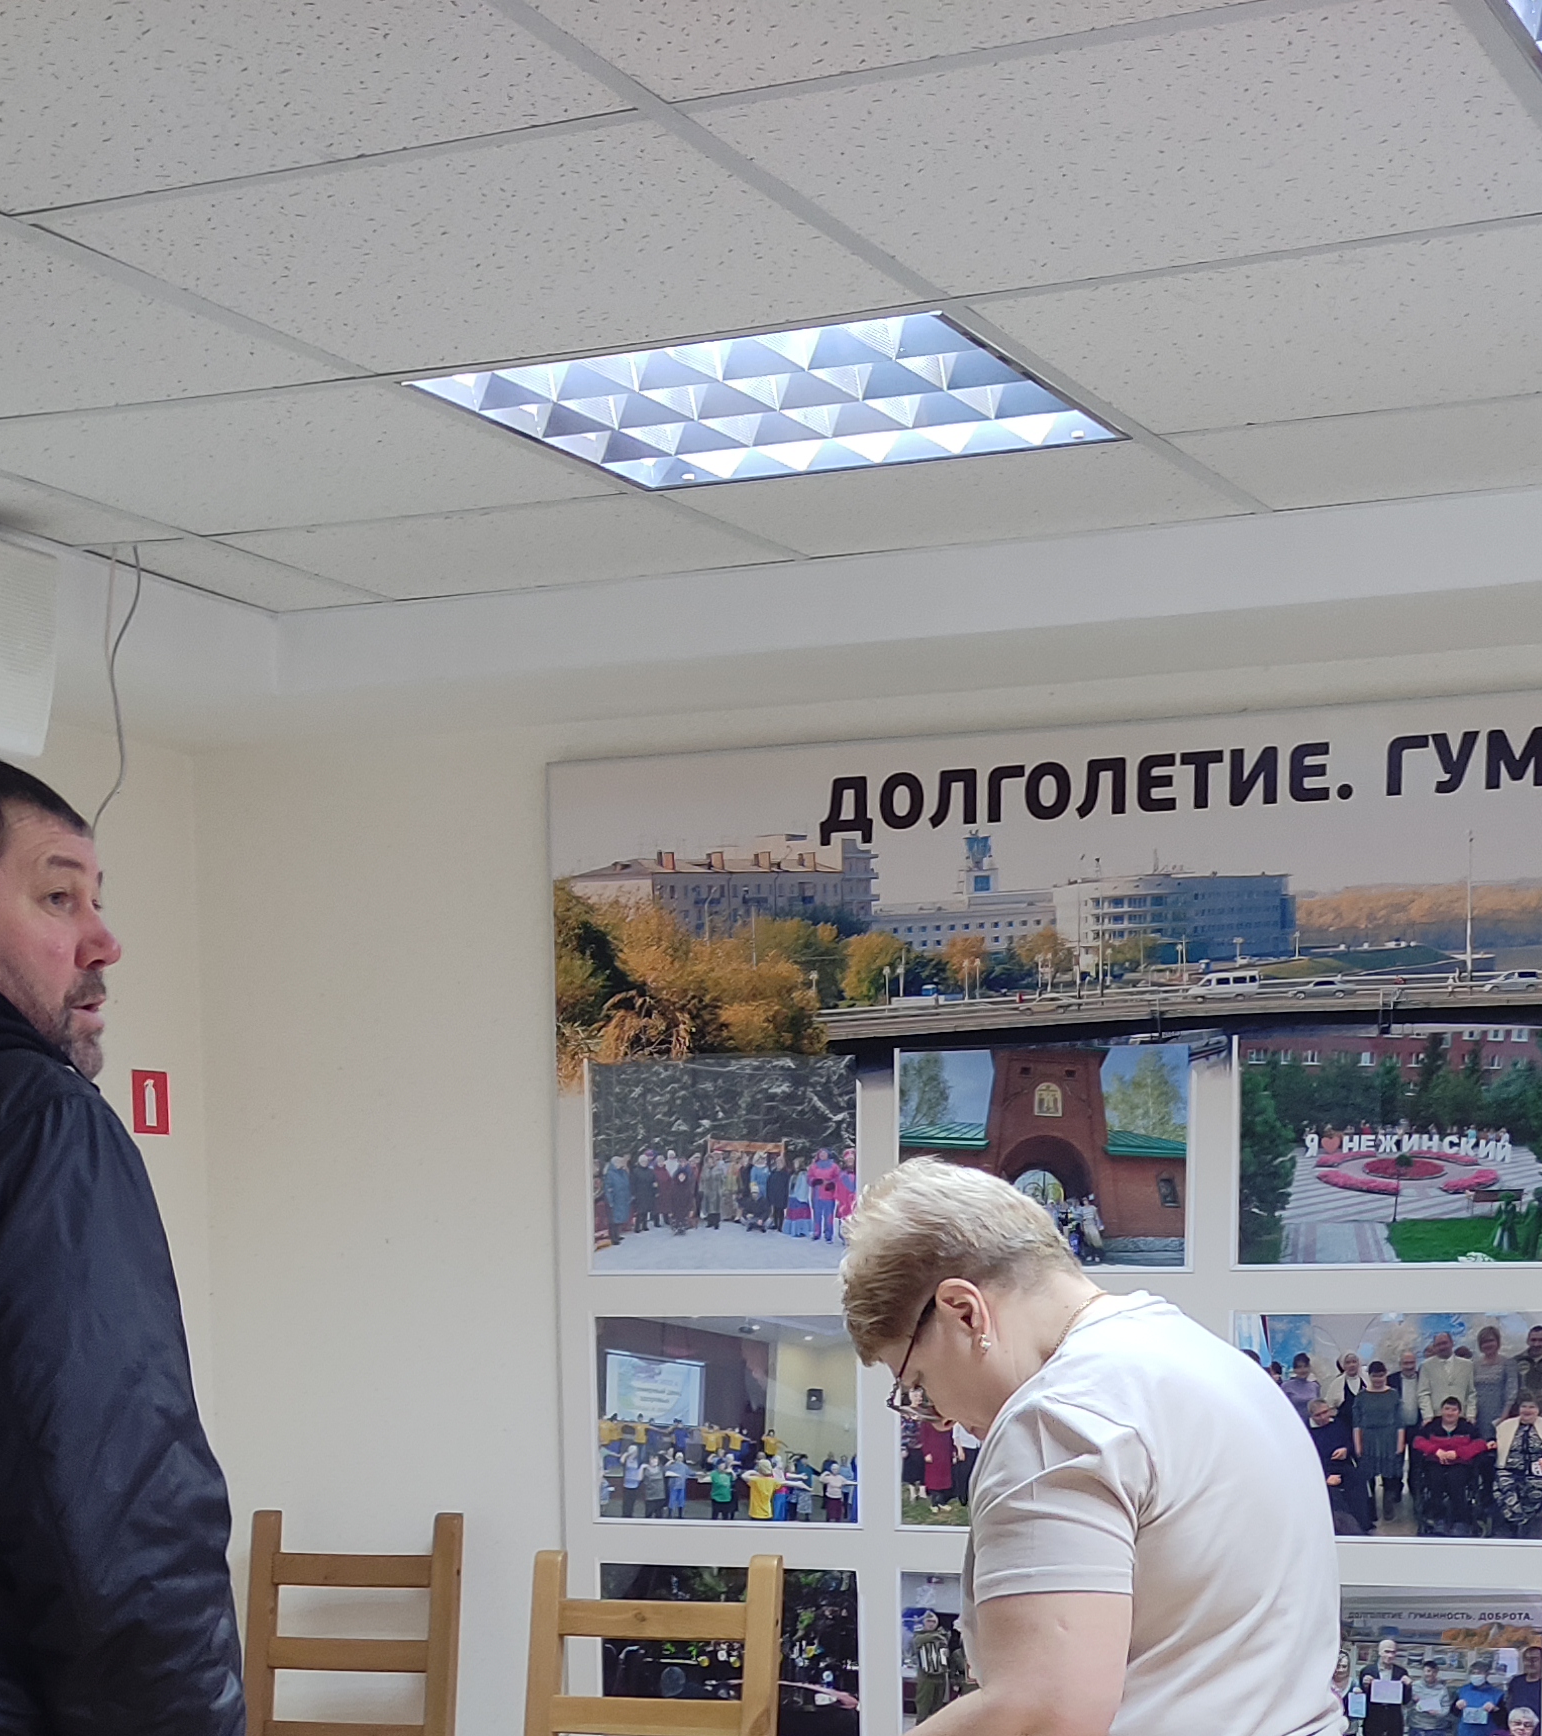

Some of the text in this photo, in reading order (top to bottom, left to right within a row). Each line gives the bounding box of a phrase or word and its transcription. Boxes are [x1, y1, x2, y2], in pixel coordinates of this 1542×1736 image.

[819, 741, 1353, 846] ДОЛГОЛЕТИЕ.
[1305, 1133, 1512, 1162] Я НЕЖИНСКИЙ
[1478, 1611, 1534, 1621] ДОБРОТА.
